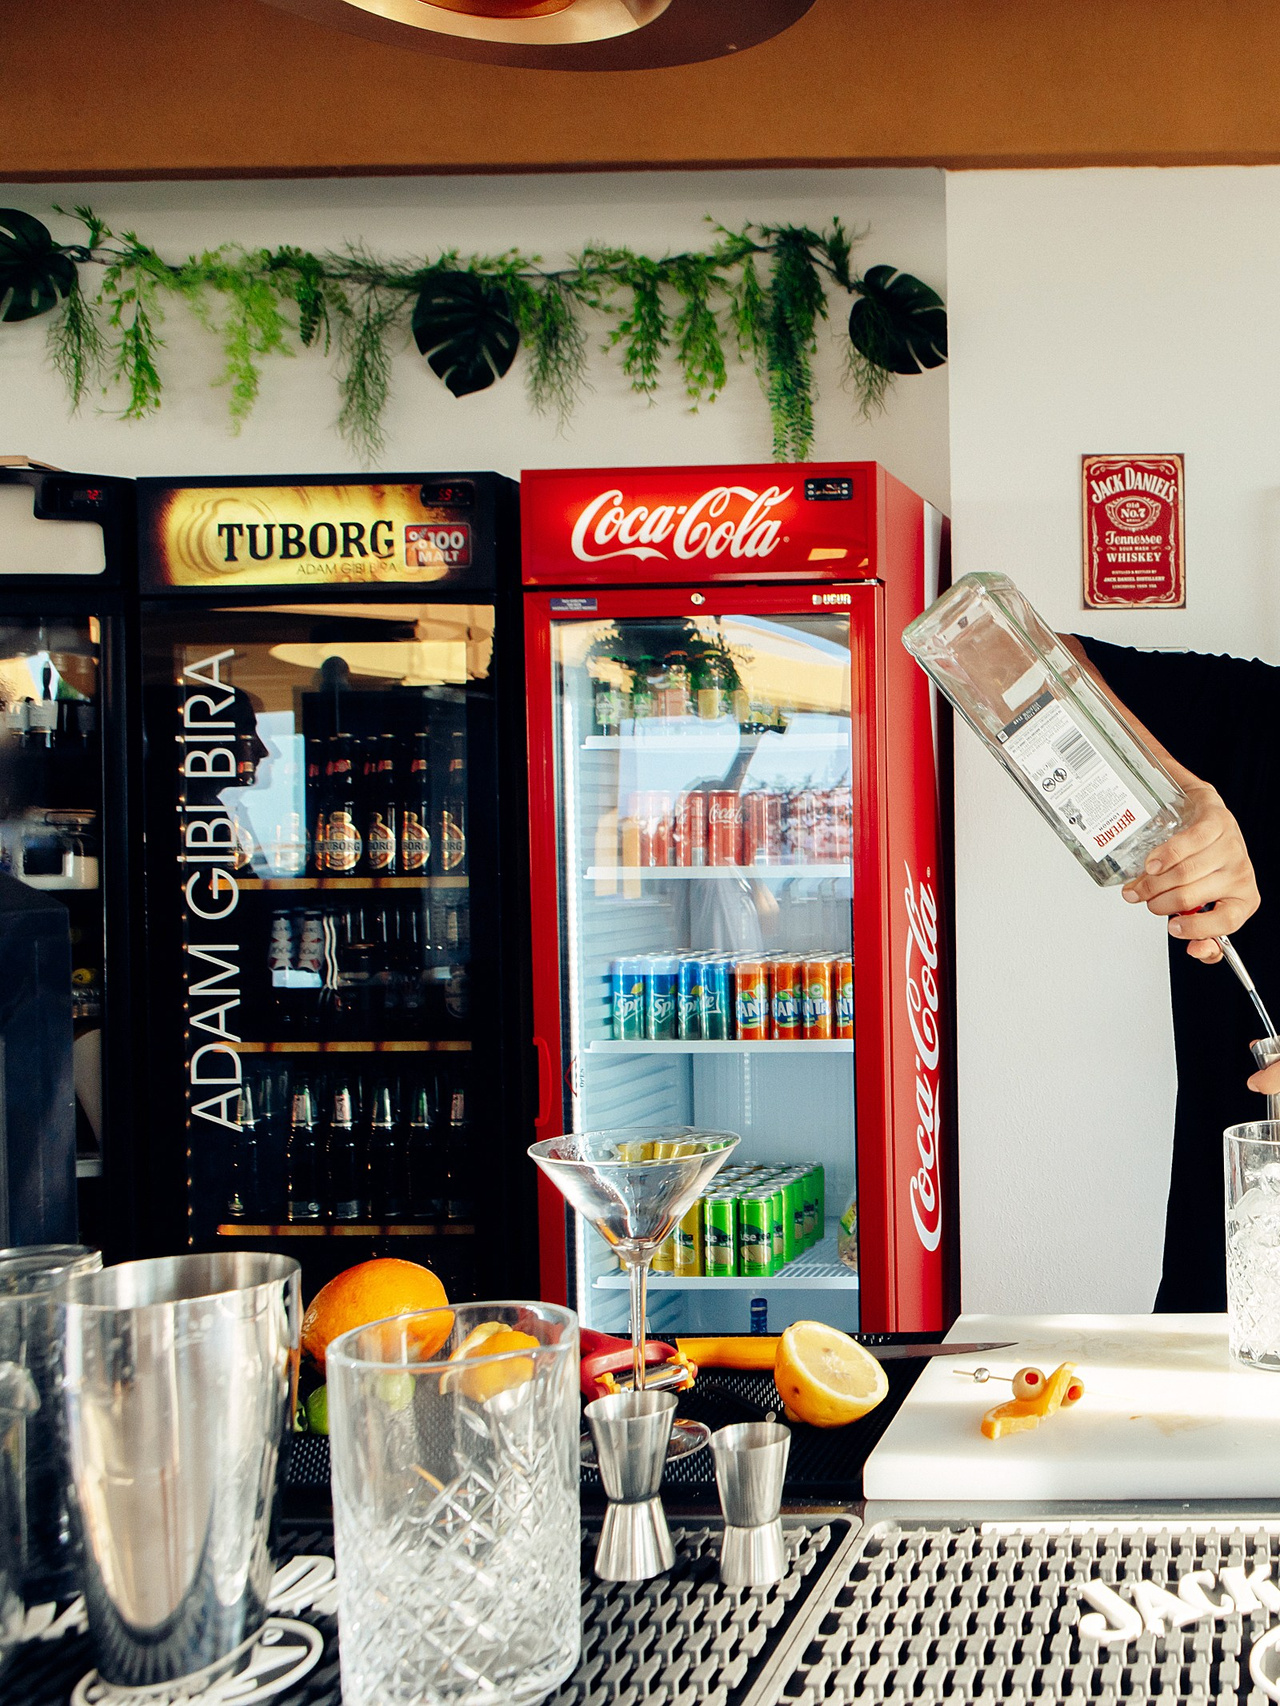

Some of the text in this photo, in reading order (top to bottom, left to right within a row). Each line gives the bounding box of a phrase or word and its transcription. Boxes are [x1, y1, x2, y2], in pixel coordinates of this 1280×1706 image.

[1090, 467, 1178, 504] JACK DANIEL'S
[217, 520, 395, 562] TUBORG
[571, 485, 795, 563] Coca-Cola
[1105, 530, 1163, 546] Tennessee
[296, 563, 338, 576] ADAM
[418, 551, 460, 562] MALT
[1106, 552, 1162, 563] WHISKEY
[1093, 808, 1136, 848] BEEFEATER
[1099, 811, 1120, 831] LONDON
[175, 648, 243, 1133] ADAM GİBİ BİRA
[904, 859, 942, 1252] Coca-Cola
